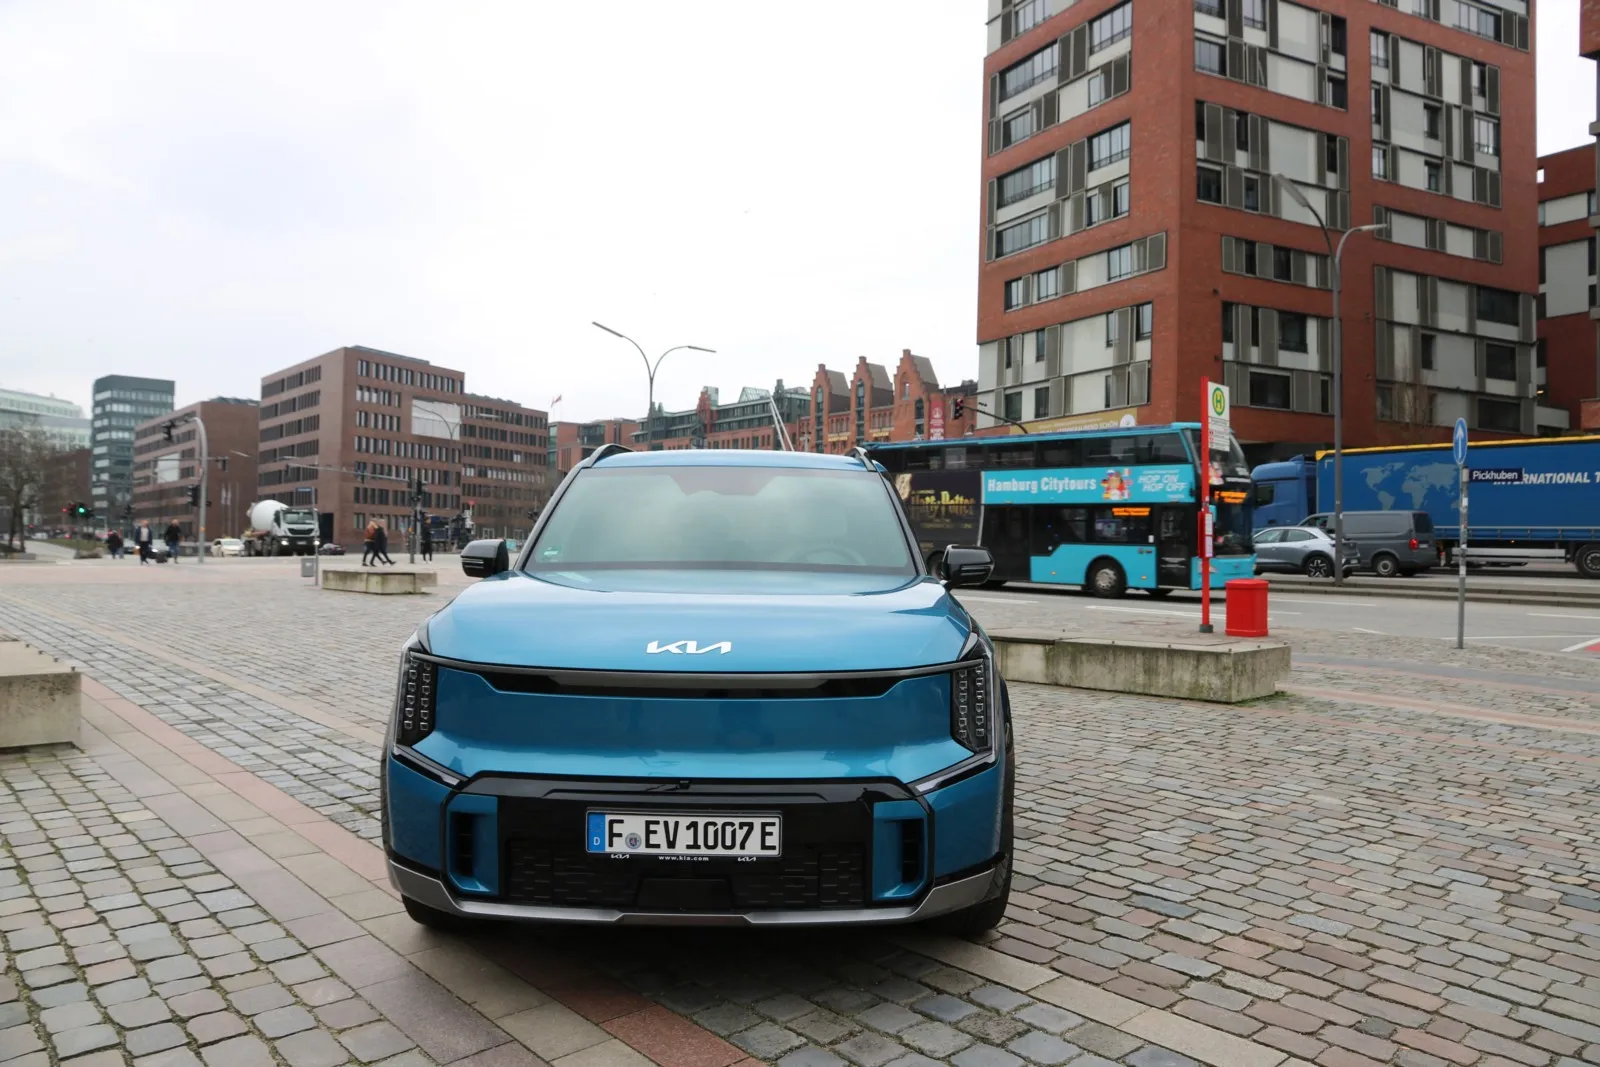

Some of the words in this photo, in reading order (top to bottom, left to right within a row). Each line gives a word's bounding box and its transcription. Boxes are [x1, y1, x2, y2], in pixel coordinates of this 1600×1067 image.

[1138, 475, 1160, 484] HOP
[1163, 475, 1179, 483] ON
[1473, 470, 1518, 480] Pickhuben
[1493, 472, 1590, 485] RNATIONAL
[987, 478, 1038, 493] Hamburg
[1041, 476, 1097, 493] Citytours
[1142, 483, 1164, 492] HOP
[1166, 482, 1187, 492] OFF
[646, 640, 732, 655] KIA
[608, 819, 624, 847] F
[593, 837, 600, 846] D
